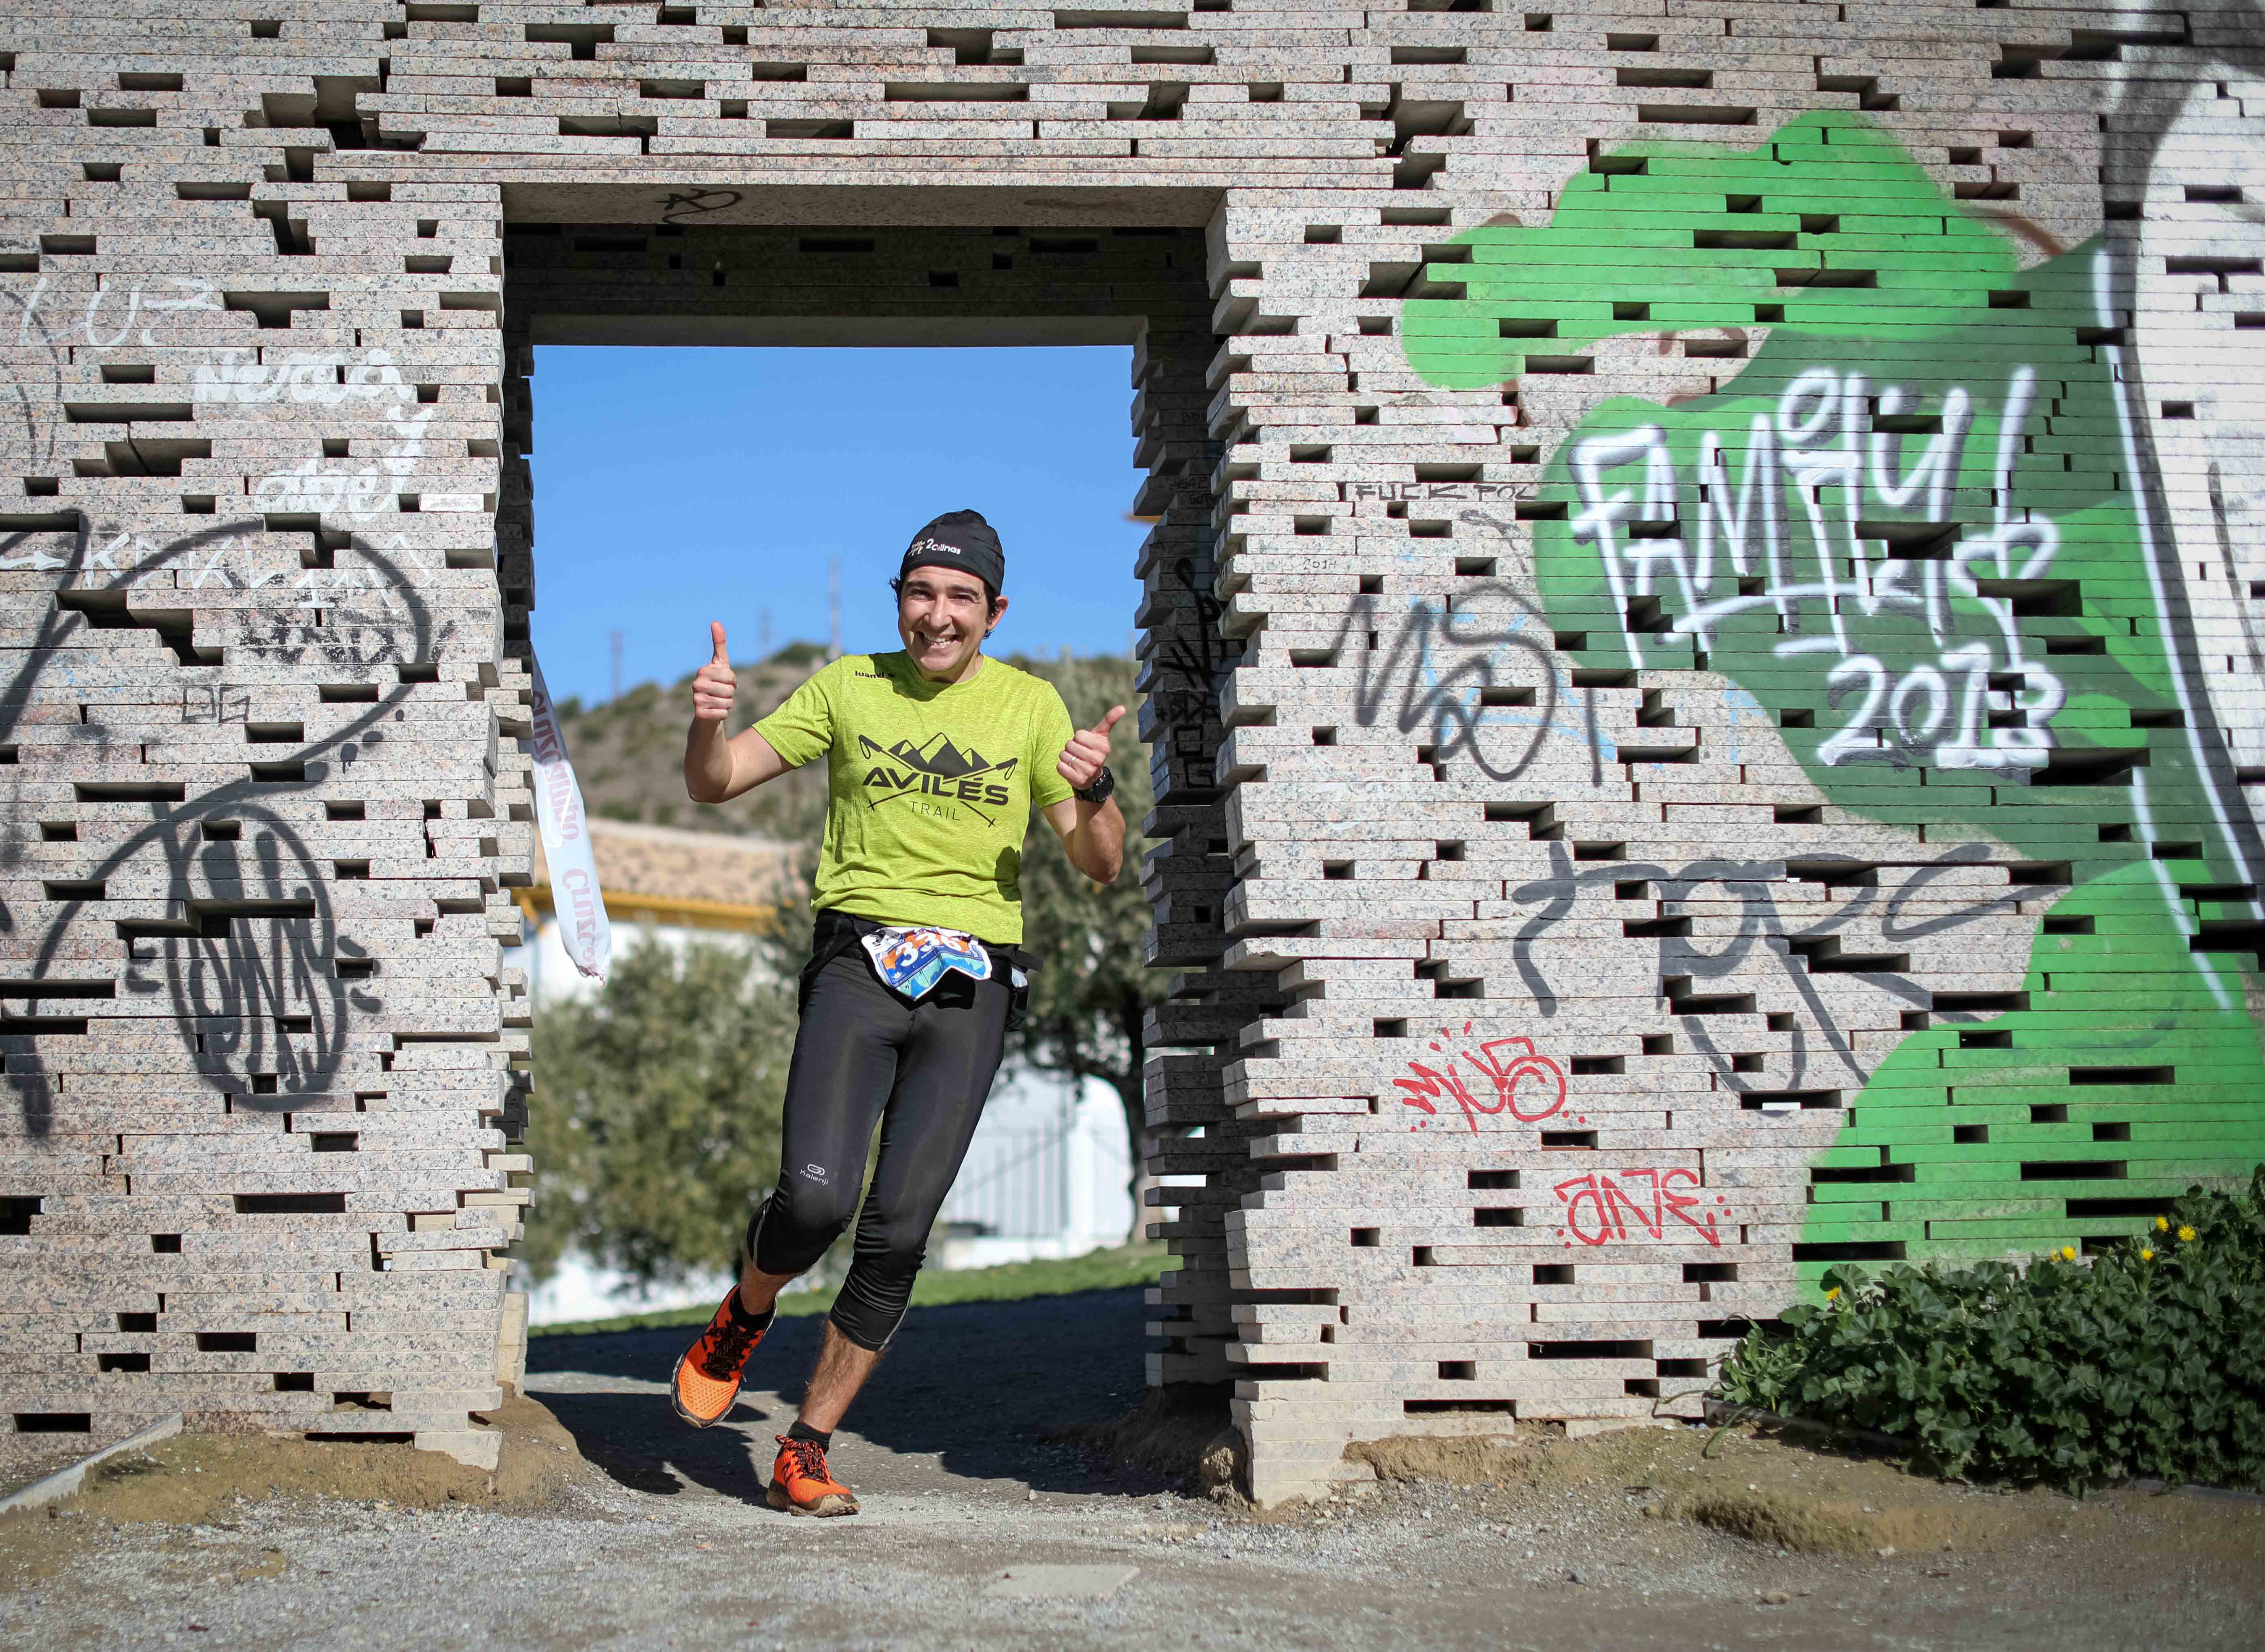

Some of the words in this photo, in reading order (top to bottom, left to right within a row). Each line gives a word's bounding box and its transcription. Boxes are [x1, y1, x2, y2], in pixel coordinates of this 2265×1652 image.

[1355, 483, 1467, 501] FUCK
[862, 767, 1009, 806] AVILÉS
[909, 801, 961, 821] TRAIL
